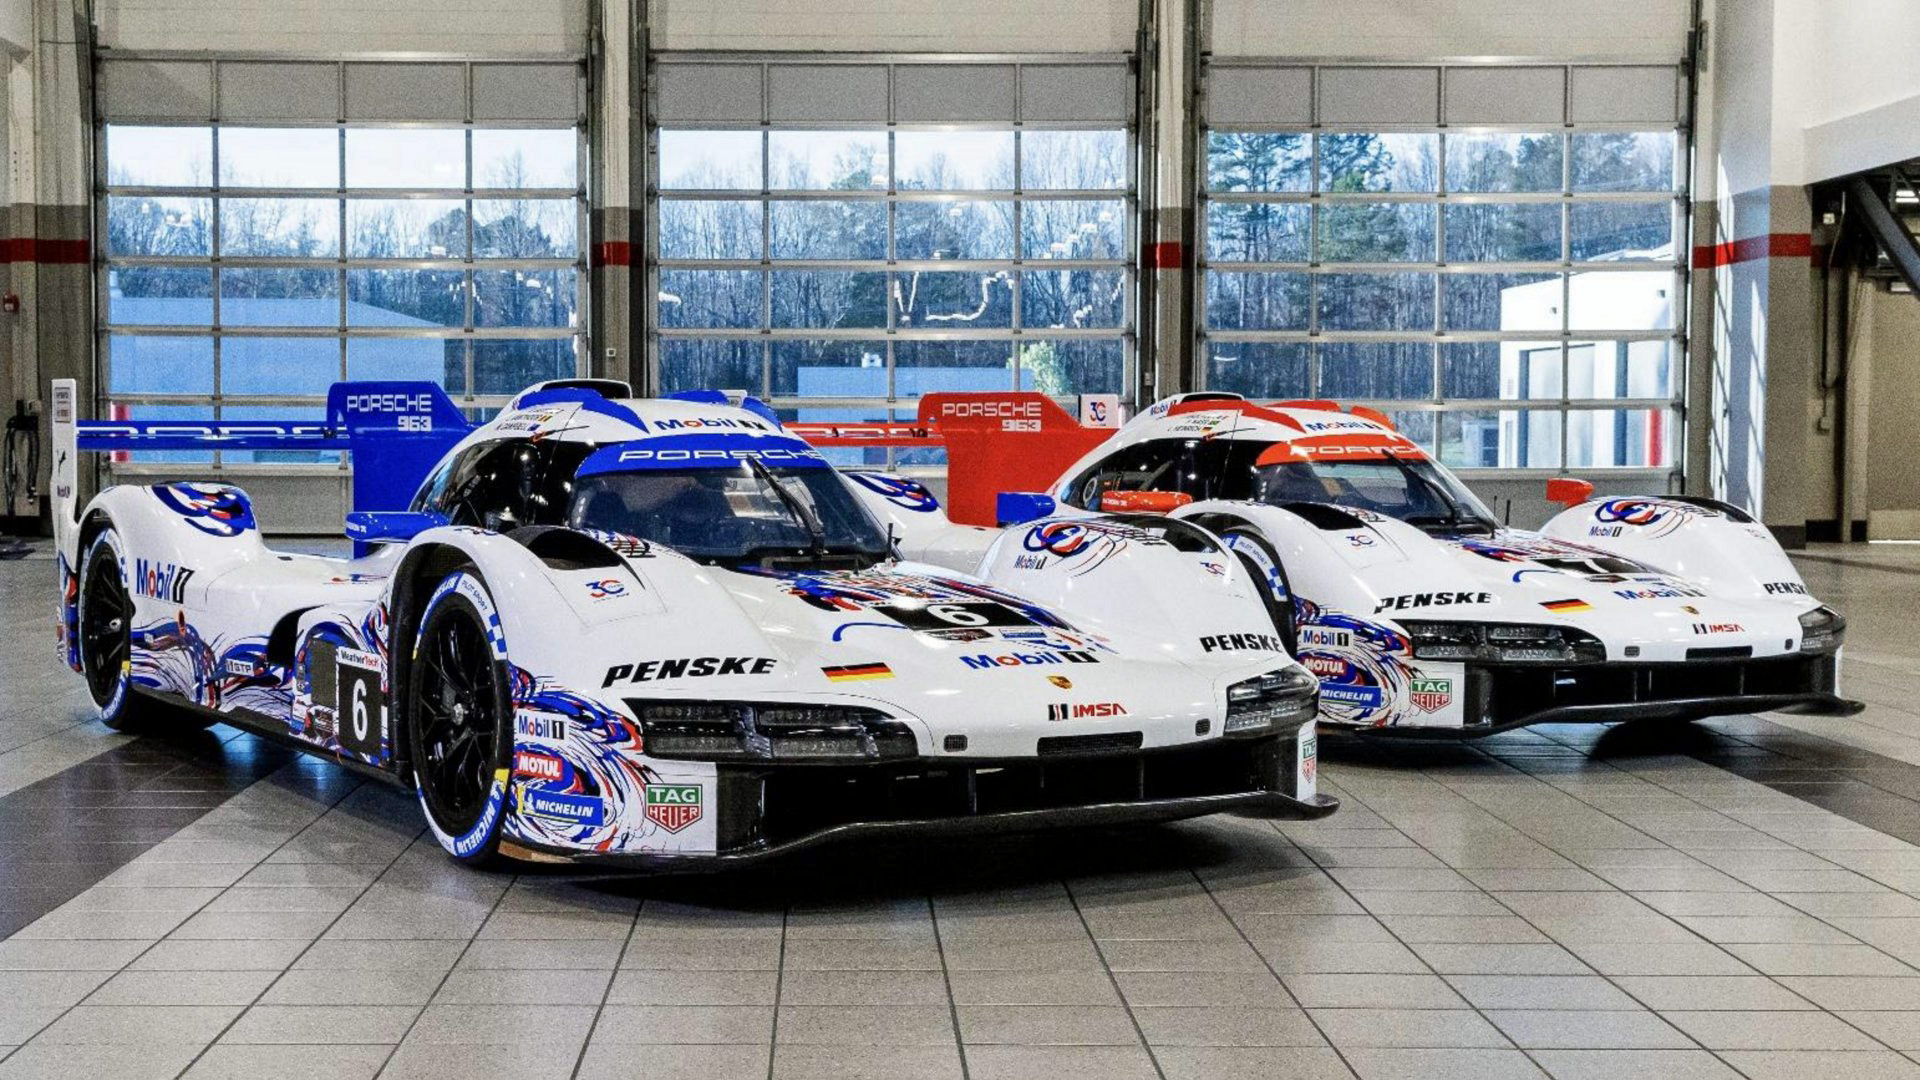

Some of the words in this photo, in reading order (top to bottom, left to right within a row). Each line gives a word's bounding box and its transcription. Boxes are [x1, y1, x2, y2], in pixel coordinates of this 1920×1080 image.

[347, 394, 432, 412] PORSCHE
[942, 402, 1041, 416] PORSCHE
[398, 415, 432, 431] 963
[653, 418, 738, 430] Mobil
[1002, 419, 1041, 432] 963
[1305, 421, 1363, 431] Mobil
[618, 449, 825, 462] PORSCHE
[1290, 445, 1421, 456] PORSC
[1589, 526, 1613, 537] Mobil
[1013, 555, 1038, 569] Mobil
[136, 558, 176, 600] Mobil
[1613, 588, 1683, 600] Mobil
[1373, 592, 1492, 614] PENSKE
[927, 604, 990, 626] 6
[1709, 623, 1745, 633] IMSA
[1199, 633, 1284, 653] PENSKE
[1303, 629, 1335, 646] Mobil
[340, 650, 380, 667] WeatherTech
[959, 651, 1063, 669] Mobil
[1304, 658, 1345, 674] MOTUL
[234, 661, 252, 673] GTP
[601, 657, 778, 689] PENSKE
[1414, 681, 1448, 692] TAG
[1320, 689, 1374, 701] MICHELIN
[1412, 694, 1448, 709] HEUER
[352, 678, 368, 741] 6
[1073, 703, 1127, 718] IMSA
[519, 715, 550, 738] Mobil
[518, 755, 561, 777] MOTUL
[651, 789, 697, 802] TAG
[536, 799, 595, 818] MICHELIN
[649, 807, 699, 828] HEUER
[456, 801, 497, 854] MICHELIN
